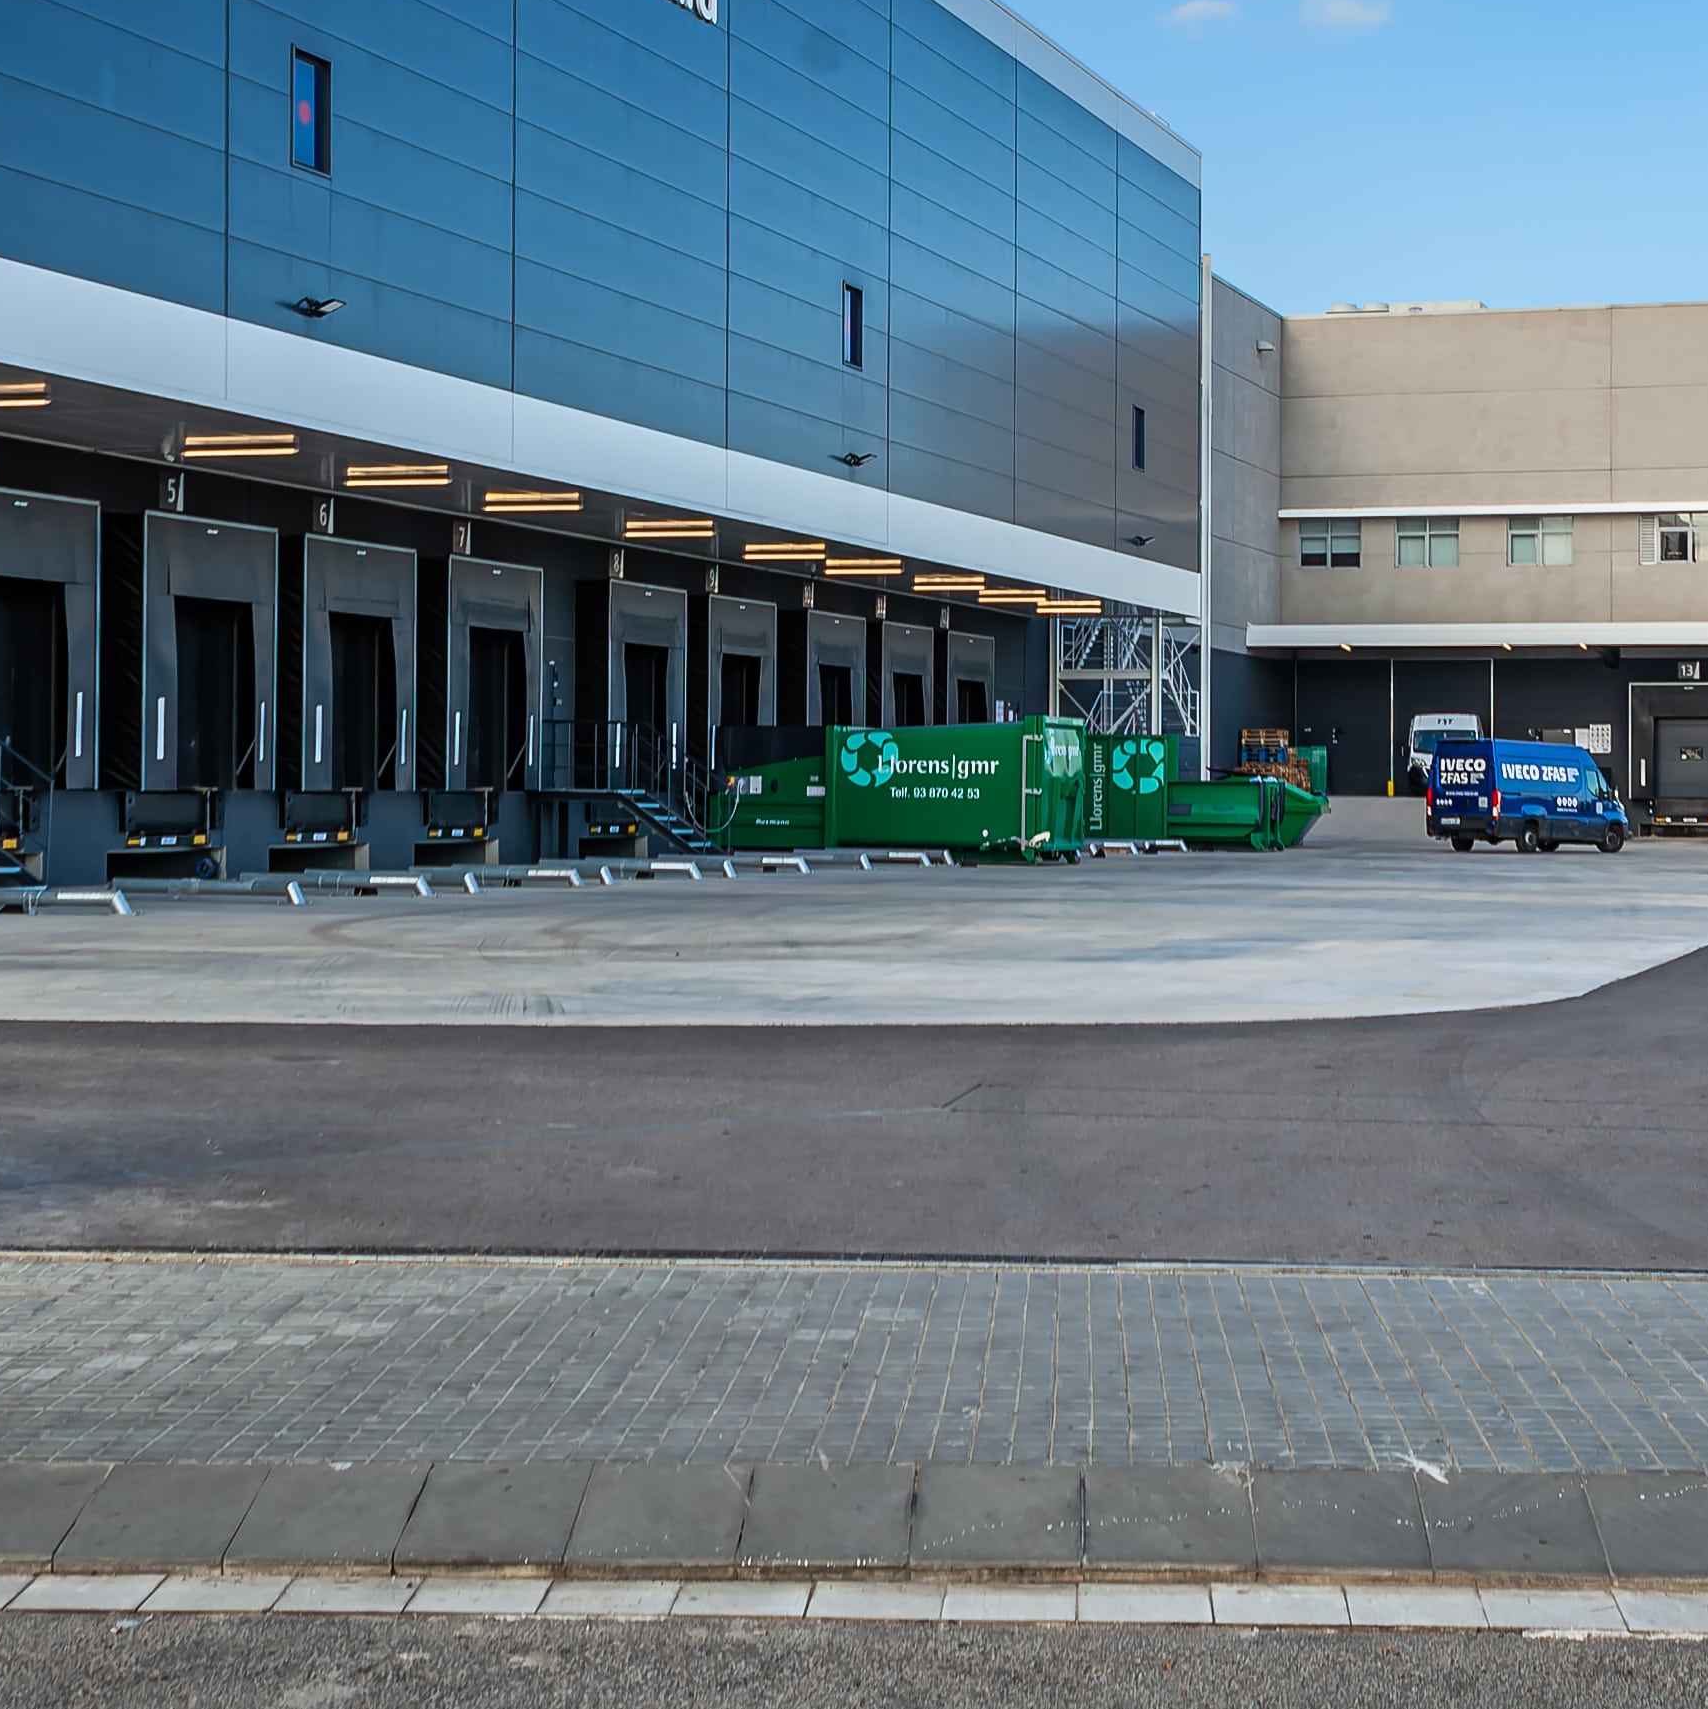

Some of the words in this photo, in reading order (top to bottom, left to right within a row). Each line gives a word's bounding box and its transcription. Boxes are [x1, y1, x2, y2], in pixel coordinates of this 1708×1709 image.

[167, 478, 176, 504] 5
[319, 503, 328, 527] 6
[458, 526, 466, 548] 7
[613, 553, 620, 573] 8
[709, 568, 715, 588] 9
[1681, 664, 1694, 677] 13
[1440, 758, 1486, 772] IVECO
[1501, 762, 1540, 781] IVECO
[1541, 765, 1567, 783] ZFAS
[1440, 772, 1468, 785] ZFAS
